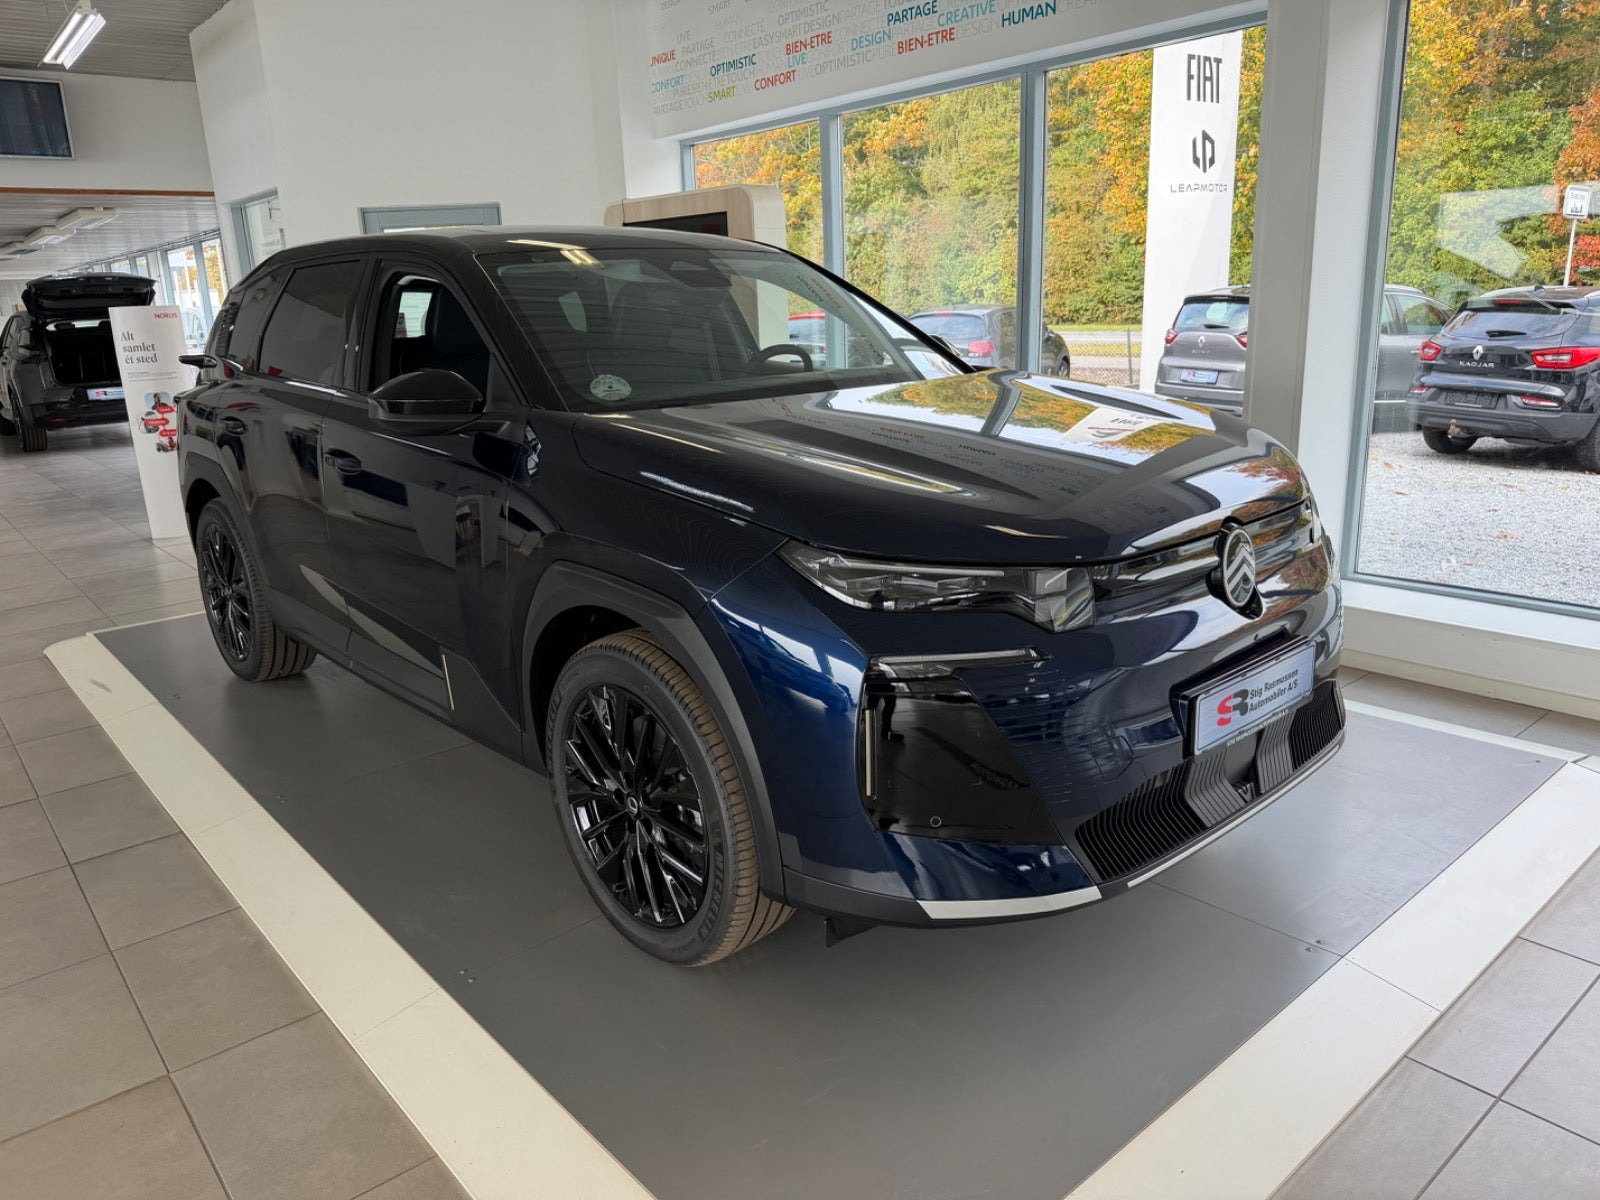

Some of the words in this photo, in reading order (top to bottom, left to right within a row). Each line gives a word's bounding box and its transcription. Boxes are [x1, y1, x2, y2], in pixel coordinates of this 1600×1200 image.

[777, 0, 829, 26] OPTIMISTIC
[676, 30, 691, 44] LIVE
[753, 32, 776, 50] EASY
[803, 12, 840, 33] DESIGN
[786, 31, 833, 56] BIEN-ETRE
[886, 0, 938, 26] PARTAGE
[787, 52, 806, 68] LIVE
[851, 28, 892, 51] DESIGN
[937, 0, 996, 27] CREATIVE
[708, 86, 736, 103] SMART
[754, 69, 797, 91] CONFORT
[814, 49, 872, 76] OPTIMISTIC
[897, 27, 955, 55] BIEN-ETRE
[1001, 0, 1057, 28] HUMAN
[710, 53, 757, 77] OPTIMISTIC
[1187, 54, 1223, 104] FIAT
[1170, 183, 1228, 193] LEAPMOTOR
[120, 331, 134, 342] Alt
[122, 342, 156, 353] samlet
[136, 353, 158, 364] sted
[1459, 360, 1495, 368] KADJAR
[1249, 686, 1263, 700] Stig
[1264, 669, 1299, 692] Rasmussen
[1249, 687, 1287, 713] Automobiler
[1287, 679, 1298, 692] A/S
[697, 848, 726, 943] MICHELIN
